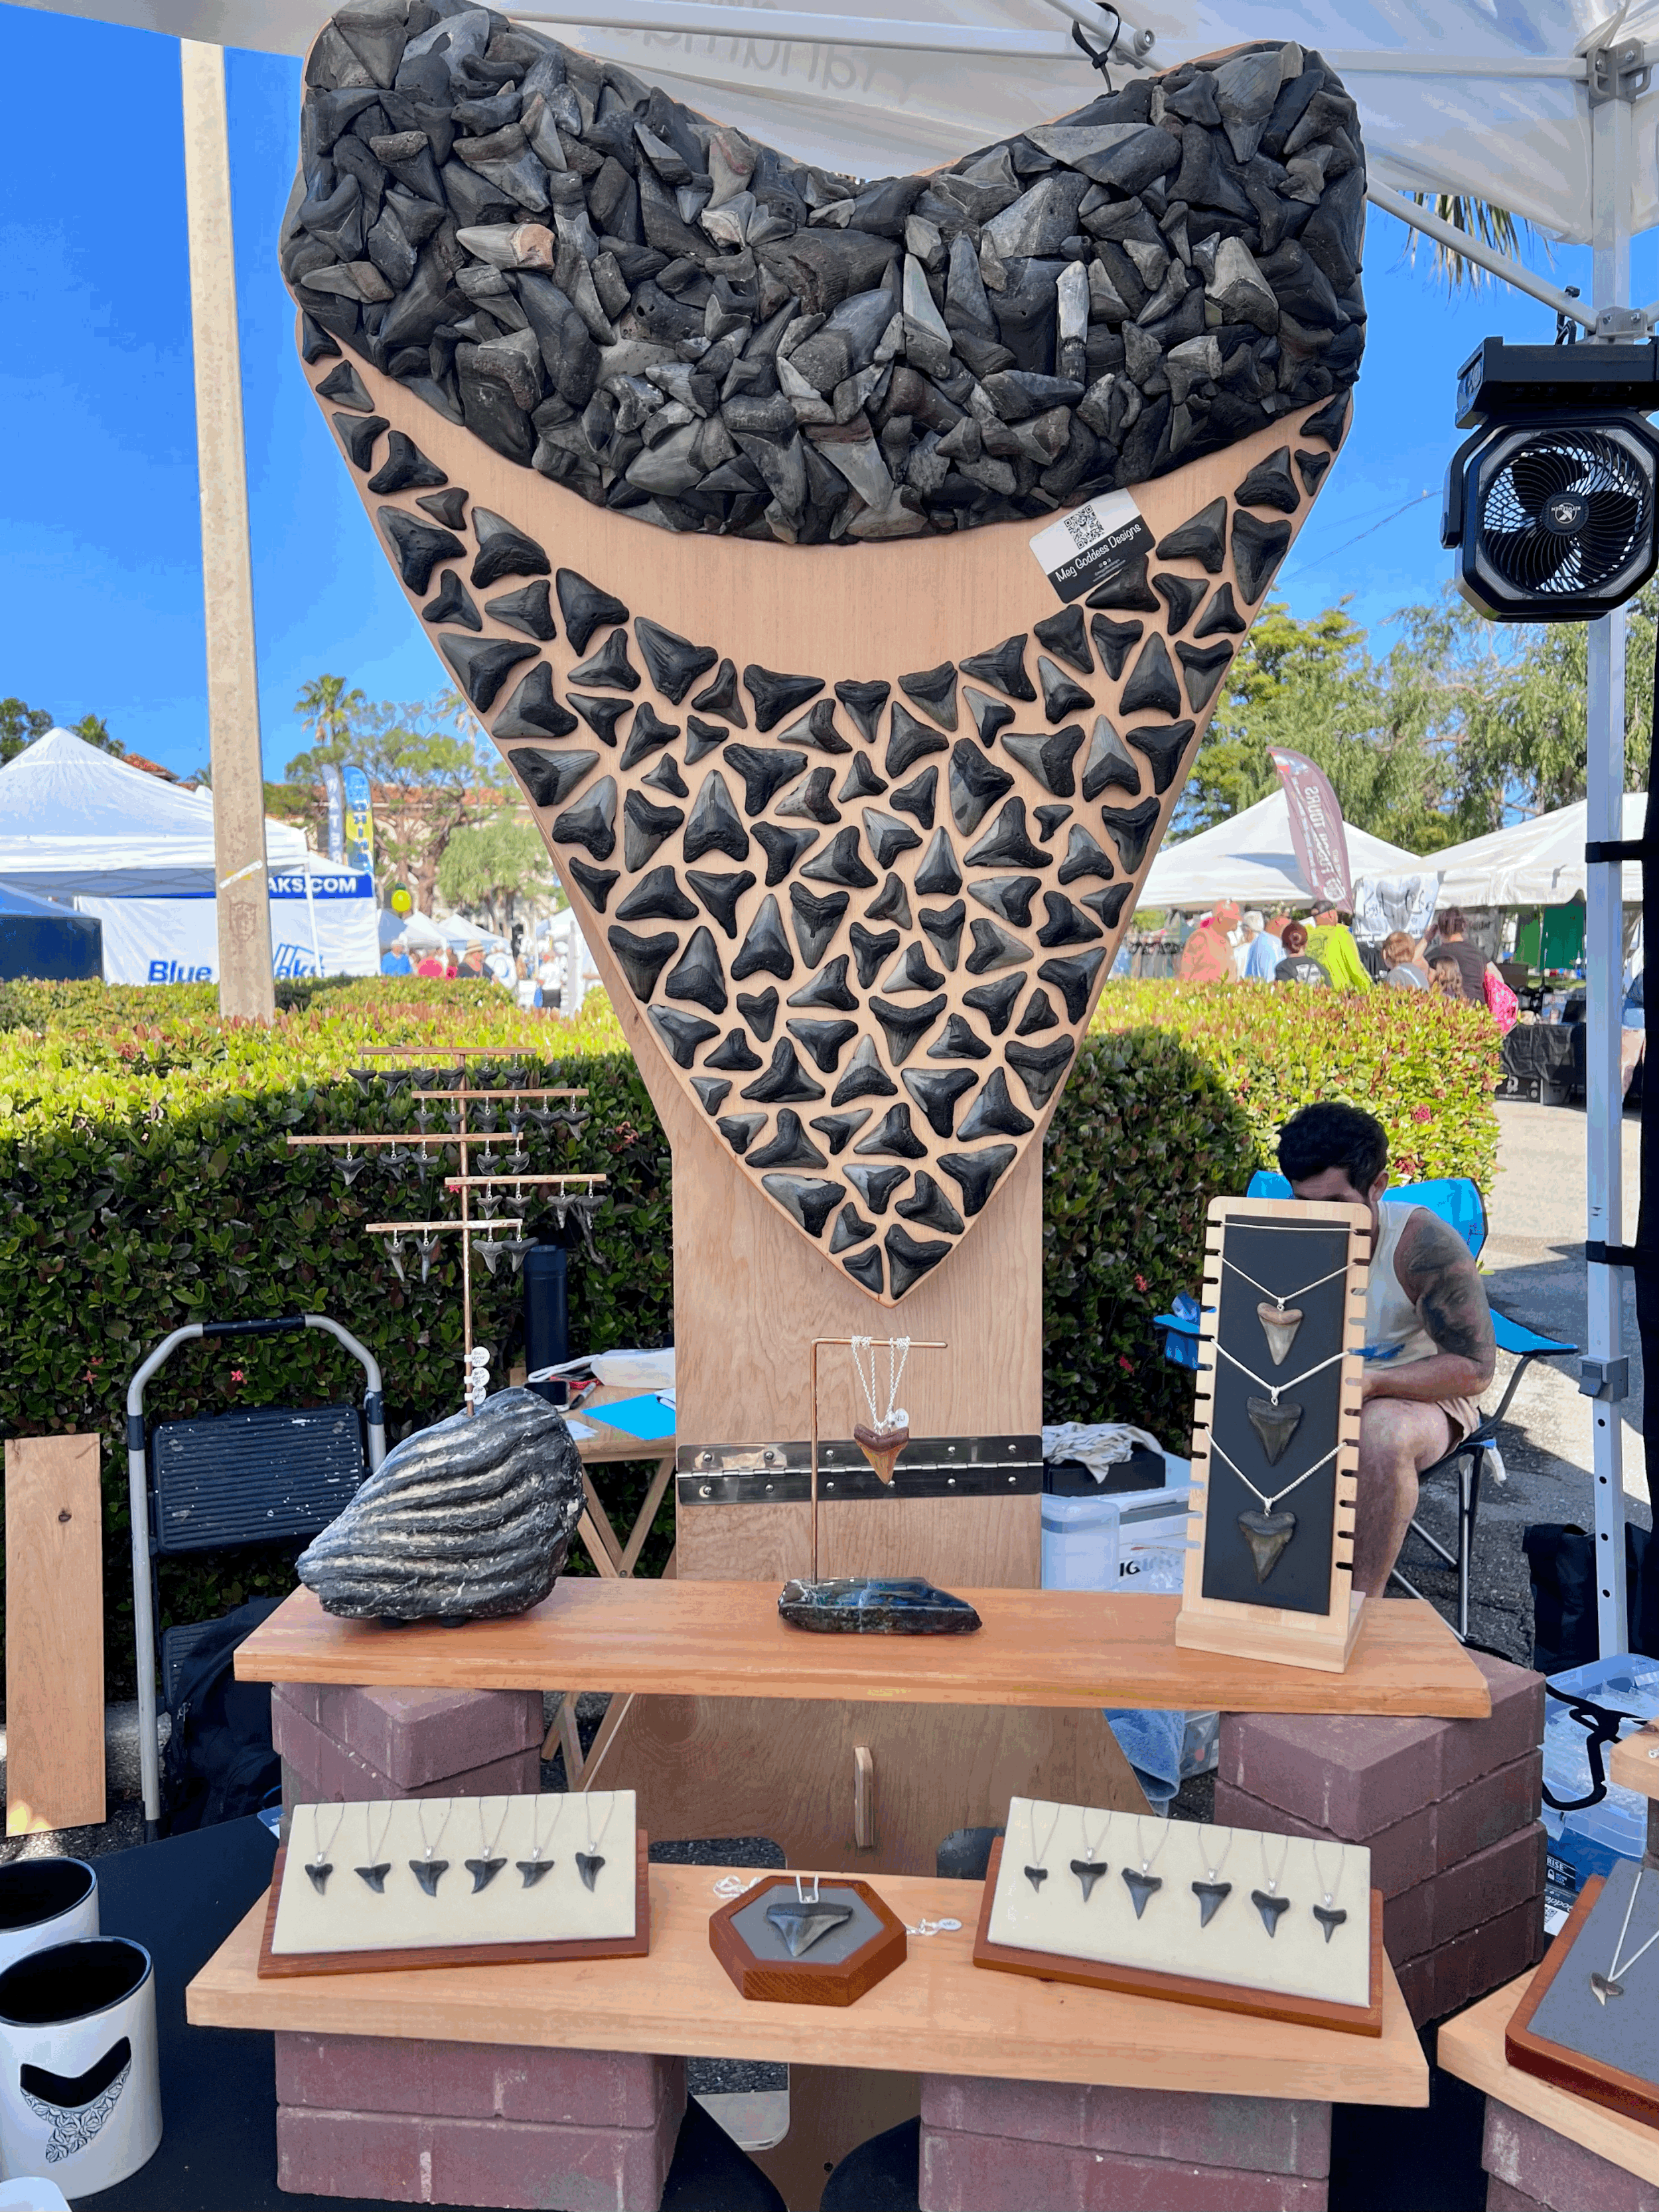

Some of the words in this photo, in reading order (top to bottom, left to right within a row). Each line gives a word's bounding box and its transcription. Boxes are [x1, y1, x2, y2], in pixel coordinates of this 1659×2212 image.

[1055, 566, 1078, 582] Meg
[1074, 544, 1110, 569] Goddess
[1108, 524, 1142, 548] Designs
[149, 960, 212, 983] Blue
